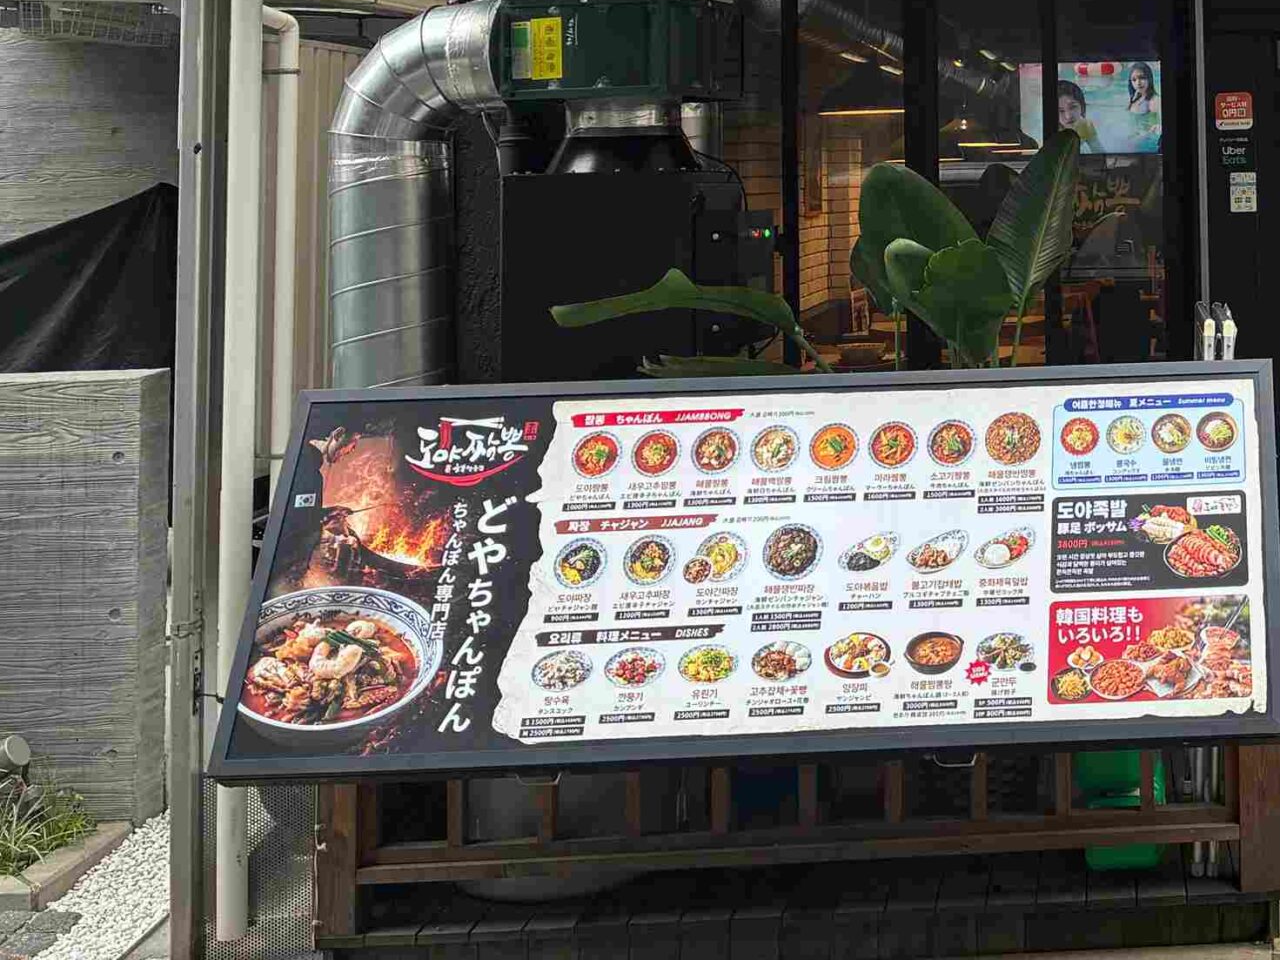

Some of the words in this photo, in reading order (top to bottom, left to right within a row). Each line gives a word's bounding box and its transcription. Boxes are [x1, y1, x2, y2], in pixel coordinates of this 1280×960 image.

[1222, 146, 1247, 156] Uber
[1222, 156, 1247, 166] Eats
[1057, 500, 1128, 520] 도야족발
[1055, 606, 1144, 626] 韓国料理も
[674, 627, 710, 639] DISHES
